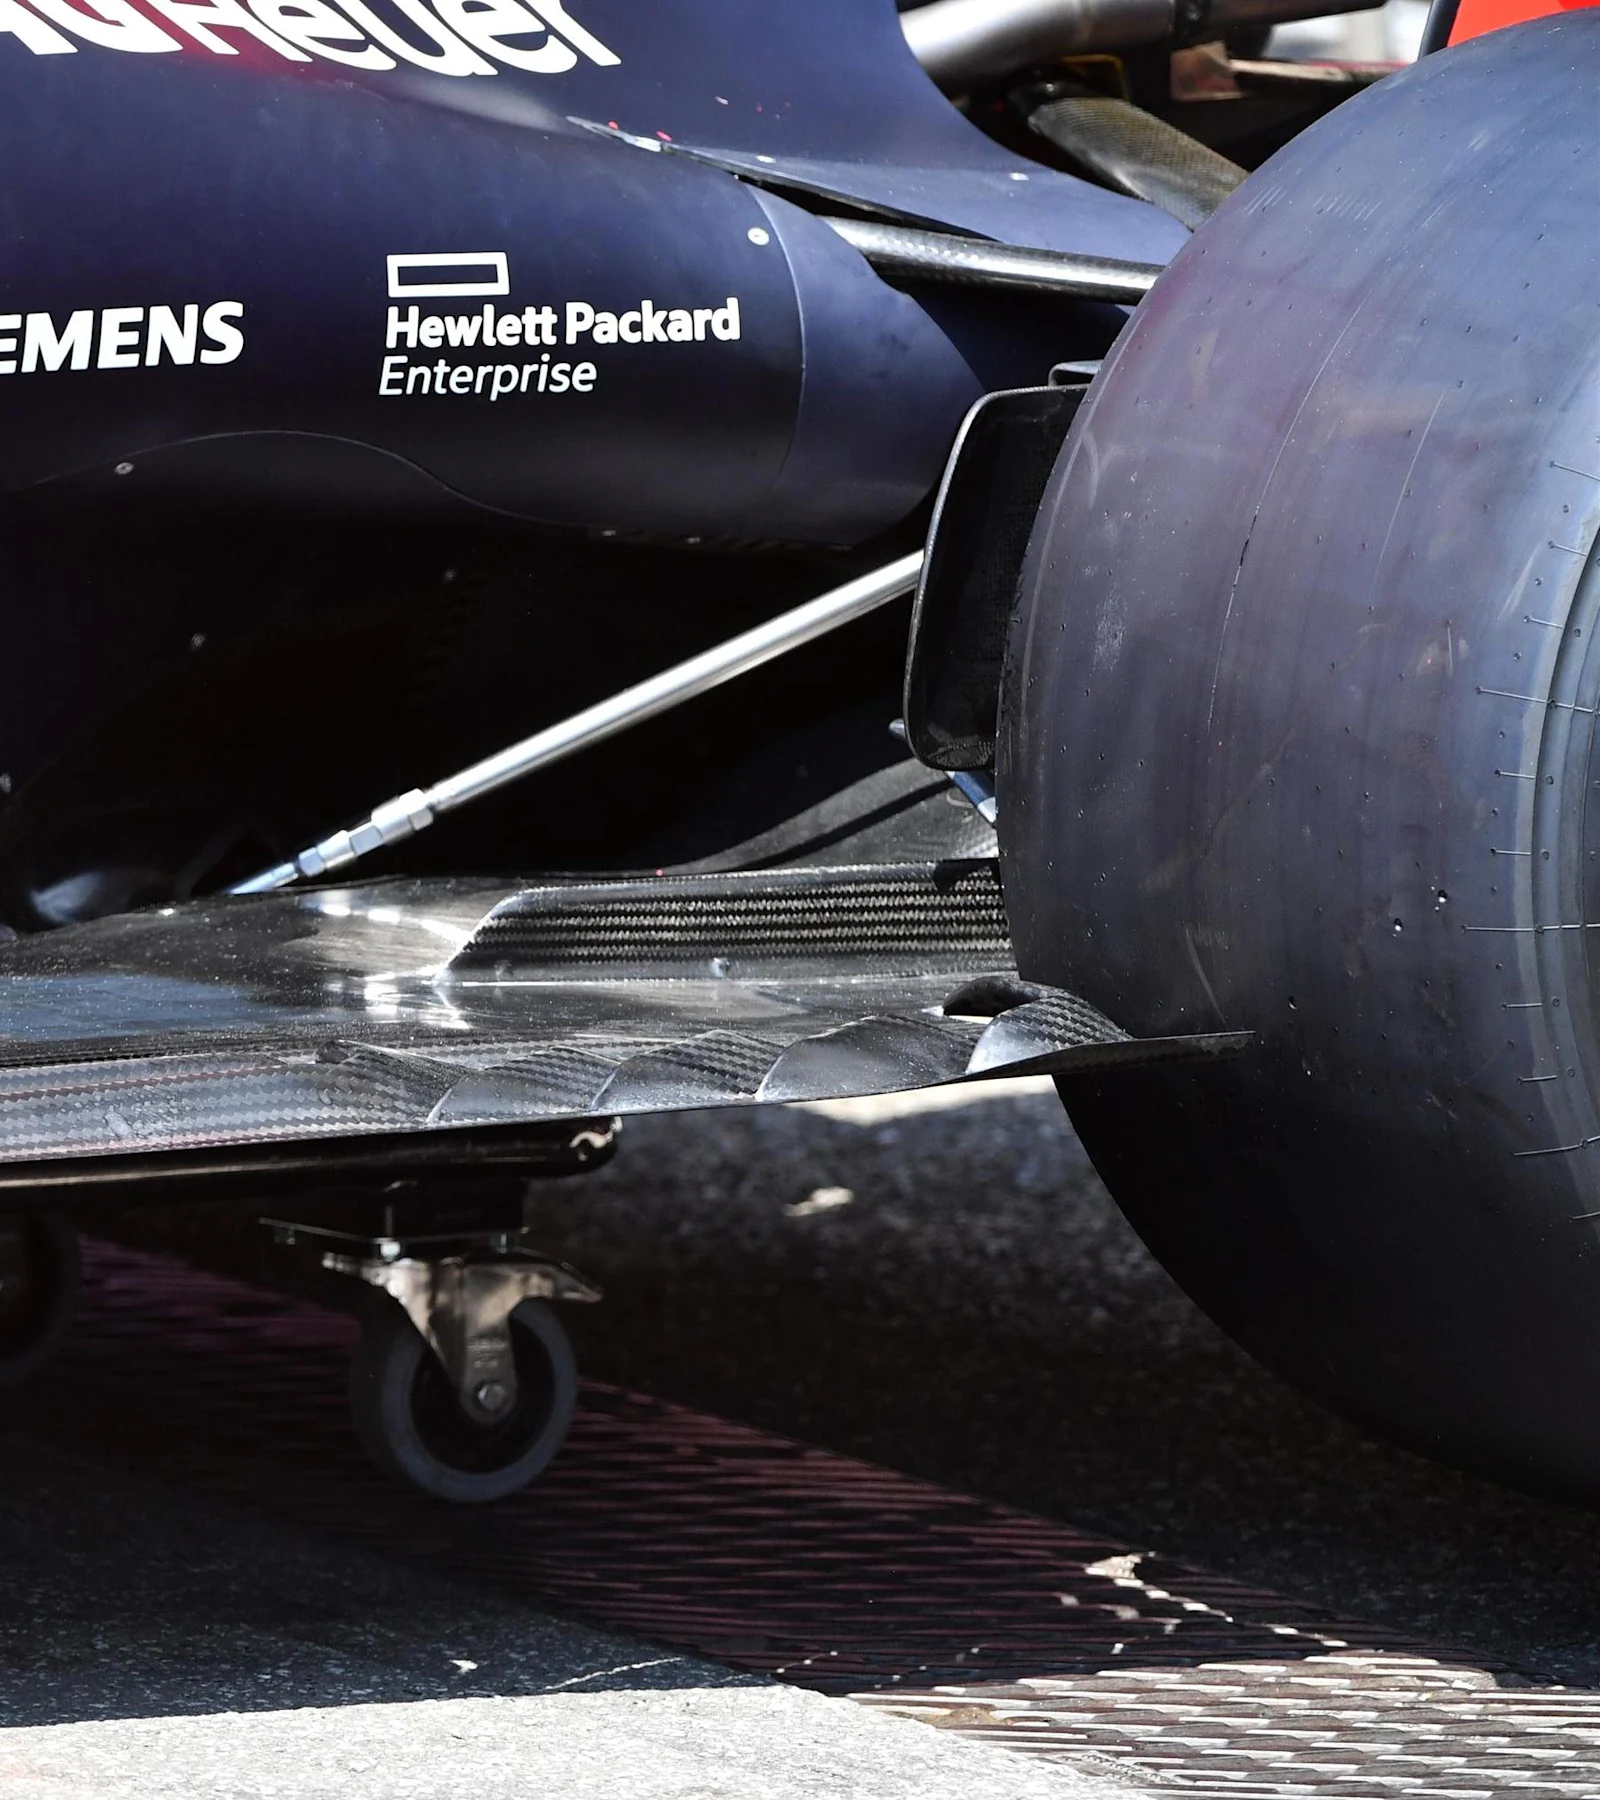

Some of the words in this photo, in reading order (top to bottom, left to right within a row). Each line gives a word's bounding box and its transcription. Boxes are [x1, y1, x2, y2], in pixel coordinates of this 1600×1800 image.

[385, 303, 558, 349] Hewlett
[565, 297, 741, 345] Packard
[379, 353, 598, 402] Enterprise
